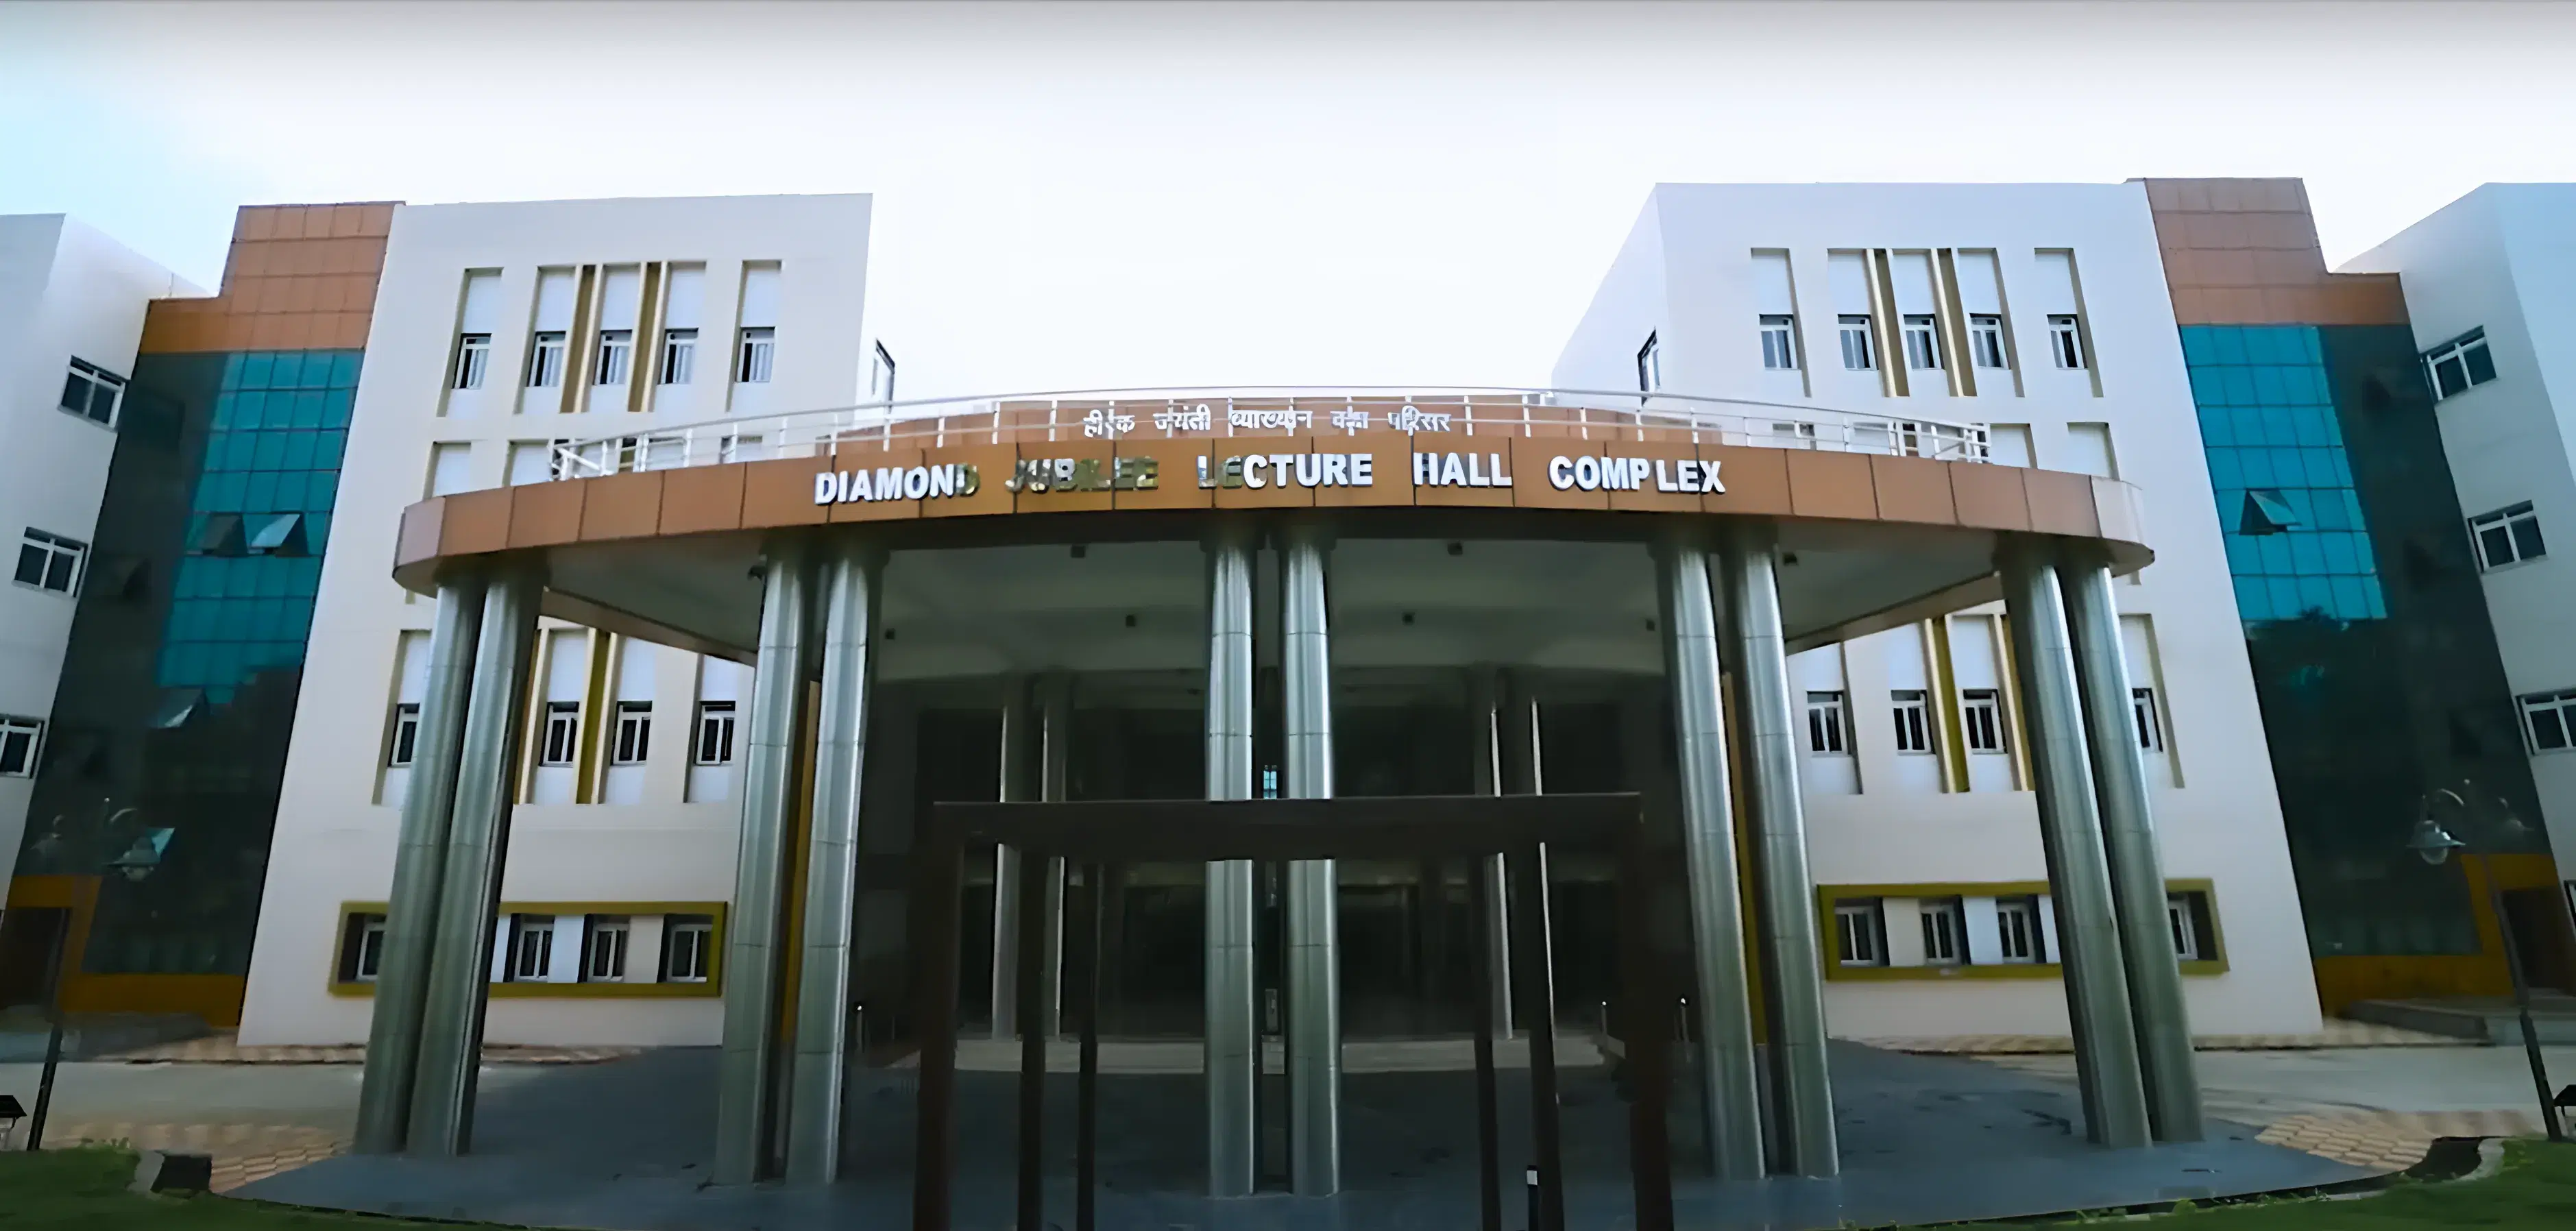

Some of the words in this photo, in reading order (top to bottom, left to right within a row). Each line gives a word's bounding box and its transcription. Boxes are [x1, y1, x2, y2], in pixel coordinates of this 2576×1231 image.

[814, 463, 980, 506] DIAMOND
[1197, 454, 1372, 489] LECTURE
[1413, 452, 1512, 487] HALL
[1548, 455, 1726, 494] COMPLEX
